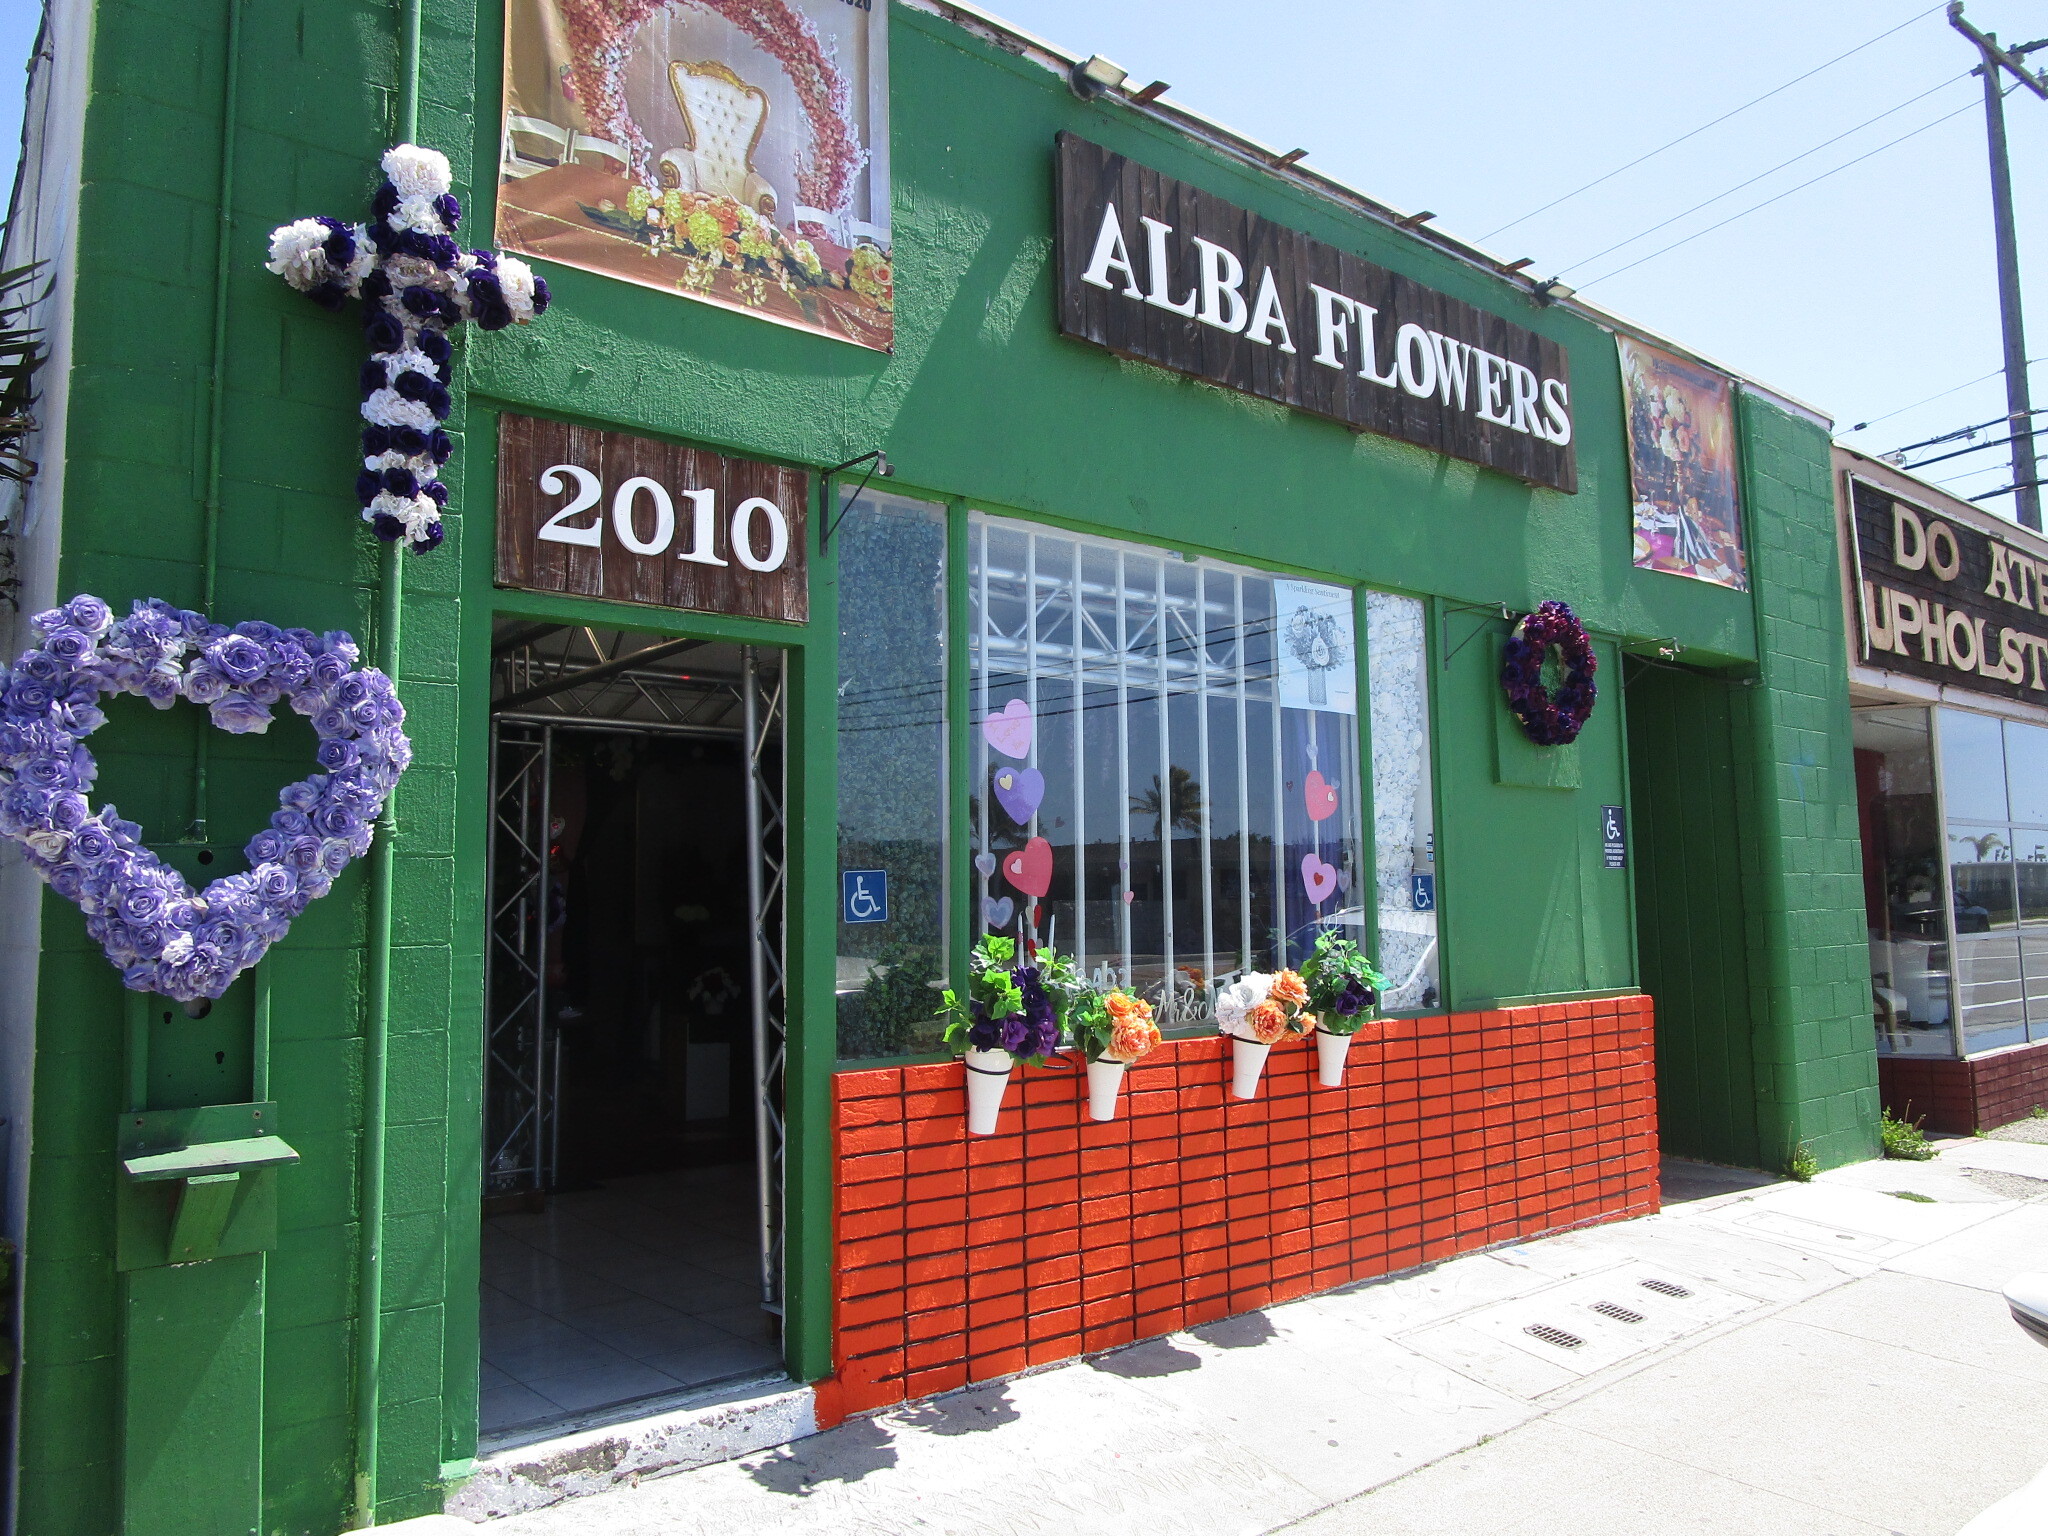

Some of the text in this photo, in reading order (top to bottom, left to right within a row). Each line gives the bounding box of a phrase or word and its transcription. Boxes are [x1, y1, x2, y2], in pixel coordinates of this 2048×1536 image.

[1081, 202, 1571, 447] ALBA FLOWERS
[537, 464, 789, 573] 2010
[1892, 502, 2048, 616] DO ATE
[1864, 580, 2048, 691] UPHOLST
